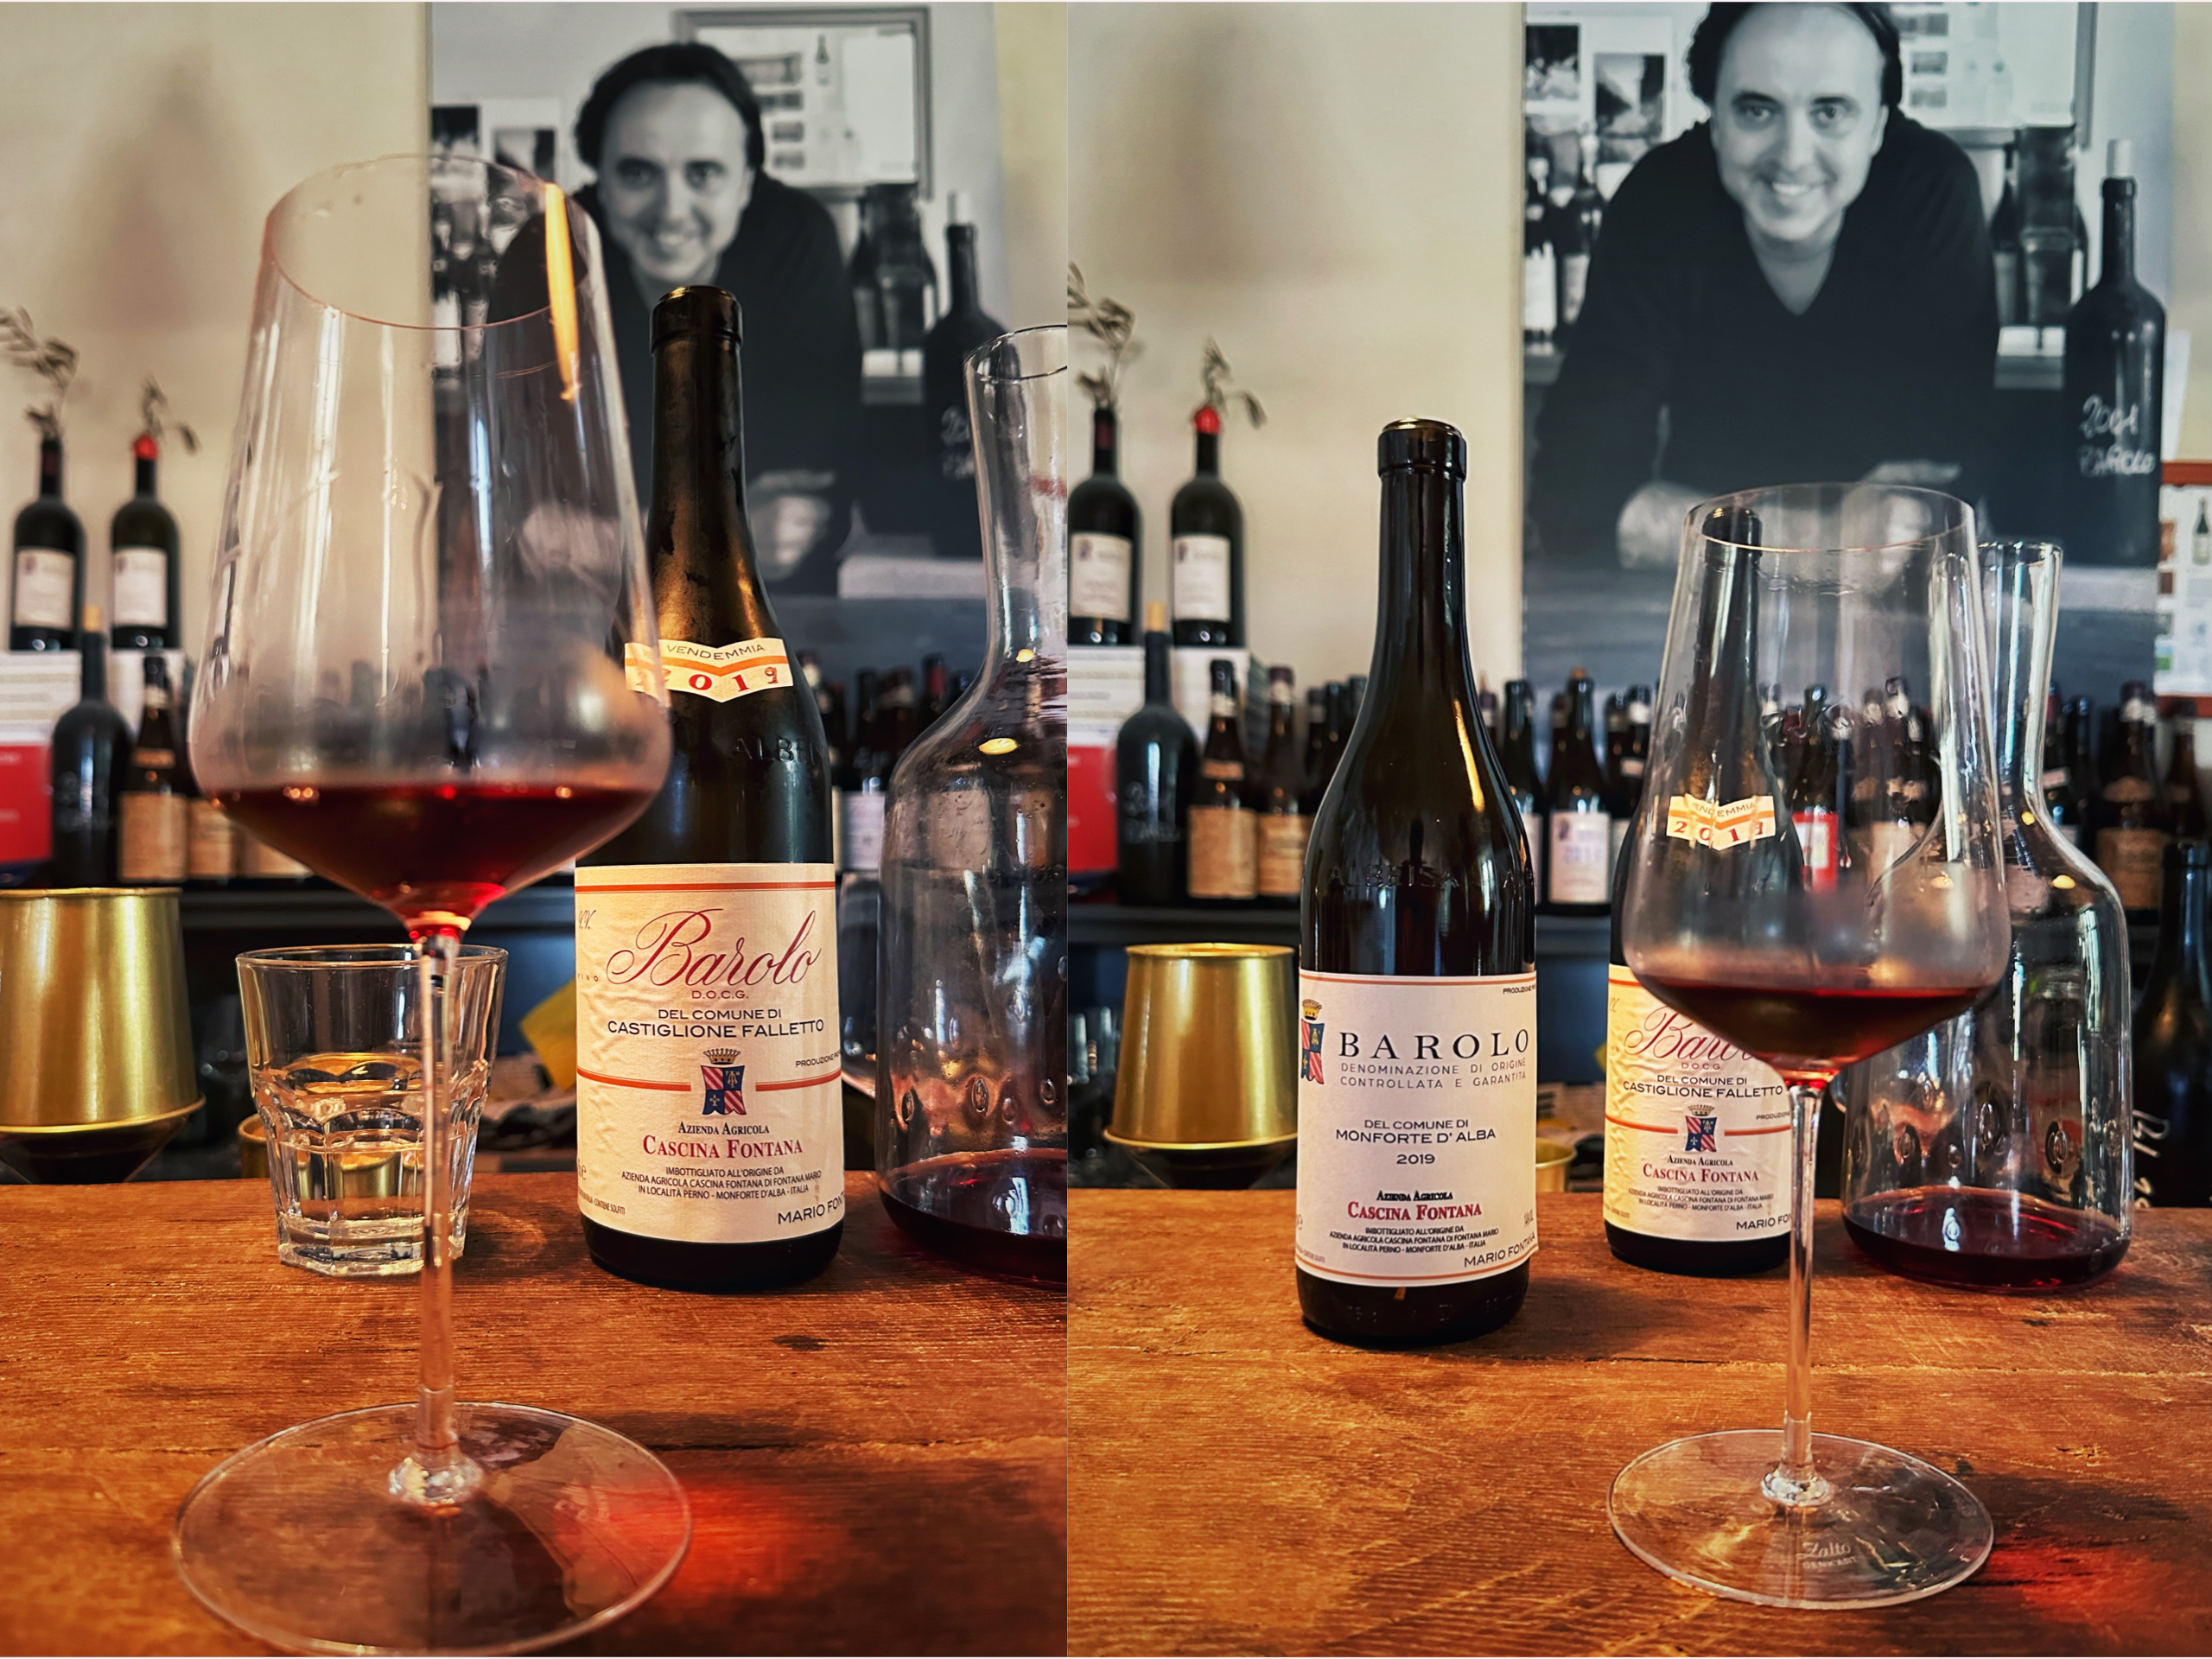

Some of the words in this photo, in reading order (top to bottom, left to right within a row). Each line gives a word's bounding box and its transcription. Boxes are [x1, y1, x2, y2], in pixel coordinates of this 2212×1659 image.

[667, 644, 766, 660] VENDEMMIA
[606, 908, 822, 987] Barolo
[691, 989, 749, 1000] D.O.C.G.
[658, 1008, 688, 1020] DEL
[692, 1009, 764, 1020] COMUNE
[767, 1008, 782, 1019] DI
[607, 1020, 737, 1038] CASTIGLIONE
[742, 1019, 824, 1038] FALLETTO
[1338, 1028, 1529, 1060] BAROLO
[1341, 1062, 1459, 1075] DENOMINAZIONE
[1471, 1063, 1483, 1074] DI
[1491, 1057, 1527, 1072] ORIGINE
[1681, 1062, 1722, 1071] D.O.C.G.
[1340, 1076, 1443, 1090] CONTROLLATA
[1455, 1078, 1463, 1088] E
[1657, 1074, 1679, 1084] DEL
[1681, 1076, 1734, 1085] COMUNE
[1624, 1080, 1713, 1098] CASTIGLIONE
[1716, 1085, 1783, 1098] FALLETTO
[1756, 1110, 1790, 1121] PRODUZION
[1364, 1119, 1391, 1129] DEL
[1393, 1120, 1453, 1130] COMUNE
[1457, 1119, 1469, 1128] DI
[1336, 1128, 1433, 1144] MONFORTE
[642, 1135, 721, 1159] CASCINA
[726, 1138, 804, 1159] FONTANA
[1396, 1154, 1436, 1165] 2019
[621, 1170, 650, 1183] AZIENDA
[650, 1174, 689, 1187] AGRICOLA
[689, 1178, 725, 1188] CASCINA
[726, 1179, 763, 1188] FONTANA
[764, 1178, 773, 1187] DI
[773, 1173, 804, 1186] FONTANA
[804, 1170, 822, 1182] MARIO
[665, 1166, 725, 1178] IMBOTTIGLIATO
[727, 1166, 772, 1178] ALL'ORIGINE
[773, 1166, 785, 1175] DA
[1643, 1163, 1696, 1182] CASCINA
[1700, 1168, 1759, 1183] FONTANA
[638, 1185, 648, 1194] IN
[649, 1185, 683, 1198] LOCALITÀ
[683, 1189, 710, 1199] PERNO
[715, 1189, 760, 1199] MONFORTE
[760, 1187, 786, 1198] D'ALBA
[790, 1185, 809, 1196] ITALIA
[1734, 1194, 1759, 1203] FONTANA
[777, 1204, 826, 1225] MARIO
[827, 1191, 845, 1214] FON
[1347, 1201, 1411, 1221] CASCINA
[1416, 1203, 1483, 1221] FONTANA
[1669, 1201, 1688, 1210] PERNO
[1692, 1203, 1723, 1211] MONFORTE
[1365, 1226, 1414, 1236] IMBOTTIGLIATO
[1736, 1217, 1776, 1230] MARIO
[1329, 1230, 1353, 1241] AZIENDA
[1353, 1234, 1384, 1244] AGRICOLA
[1384, 1236, 1414, 1245] CASCINA
[1414, 1236, 1446, 1244] FONTANA
[1454, 1232, 1483, 1243] FONTANA
[1483, 1228, 1499, 1237] MARIO
[1379, 1245, 1402, 1254] PERNO
[1406, 1244, 1442, 1254] MONFORTE
[1469, 1240, 1486, 1249] ITALIA
[1464, 1249, 1506, 1268] MARIO
[1508, 1231, 1536, 1257] FONTANA
[1796, 1541, 1852, 1559] Zalto
